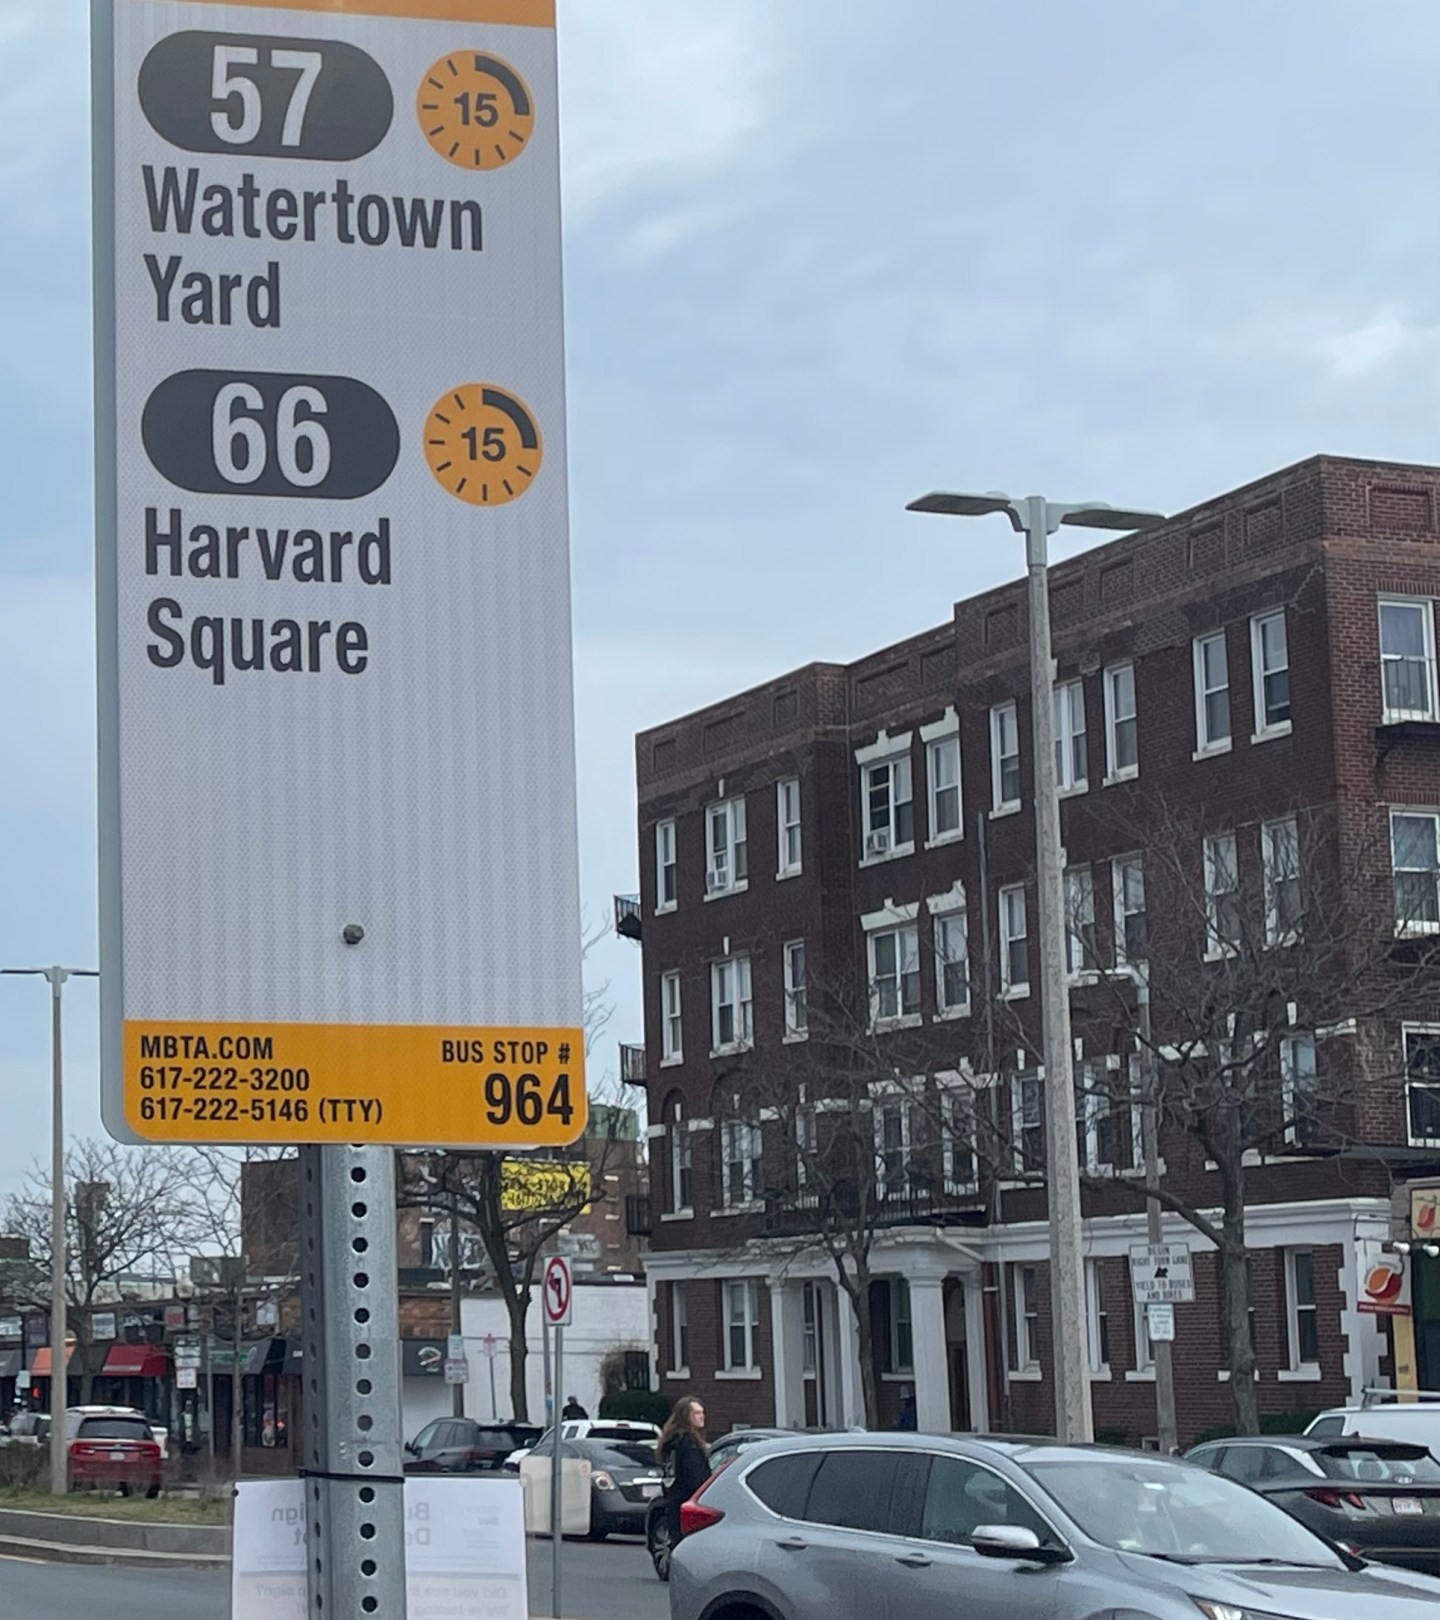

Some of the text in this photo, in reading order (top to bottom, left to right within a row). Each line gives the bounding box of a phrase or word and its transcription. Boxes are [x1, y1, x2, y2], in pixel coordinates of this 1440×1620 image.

[210, 44, 322, 147] 57
[453, 92, 499, 128] 15
[141, 164, 483, 252] Watertown
[143, 253, 280, 329] Yard
[212, 381, 331, 488] 66
[461, 426, 506, 463] 15
[145, 507, 391, 585] Harvard
[146, 597, 368, 686] Square
[140, 1035, 273, 1060] MBTA.COM
[442, 1040, 571, 1065] BUS STOP #
[140, 1066, 310, 1091] 617-222-3200
[484, 1072, 574, 1126] 964
[140, 1097, 382, 1124] 617-222-5146 (TTY)
